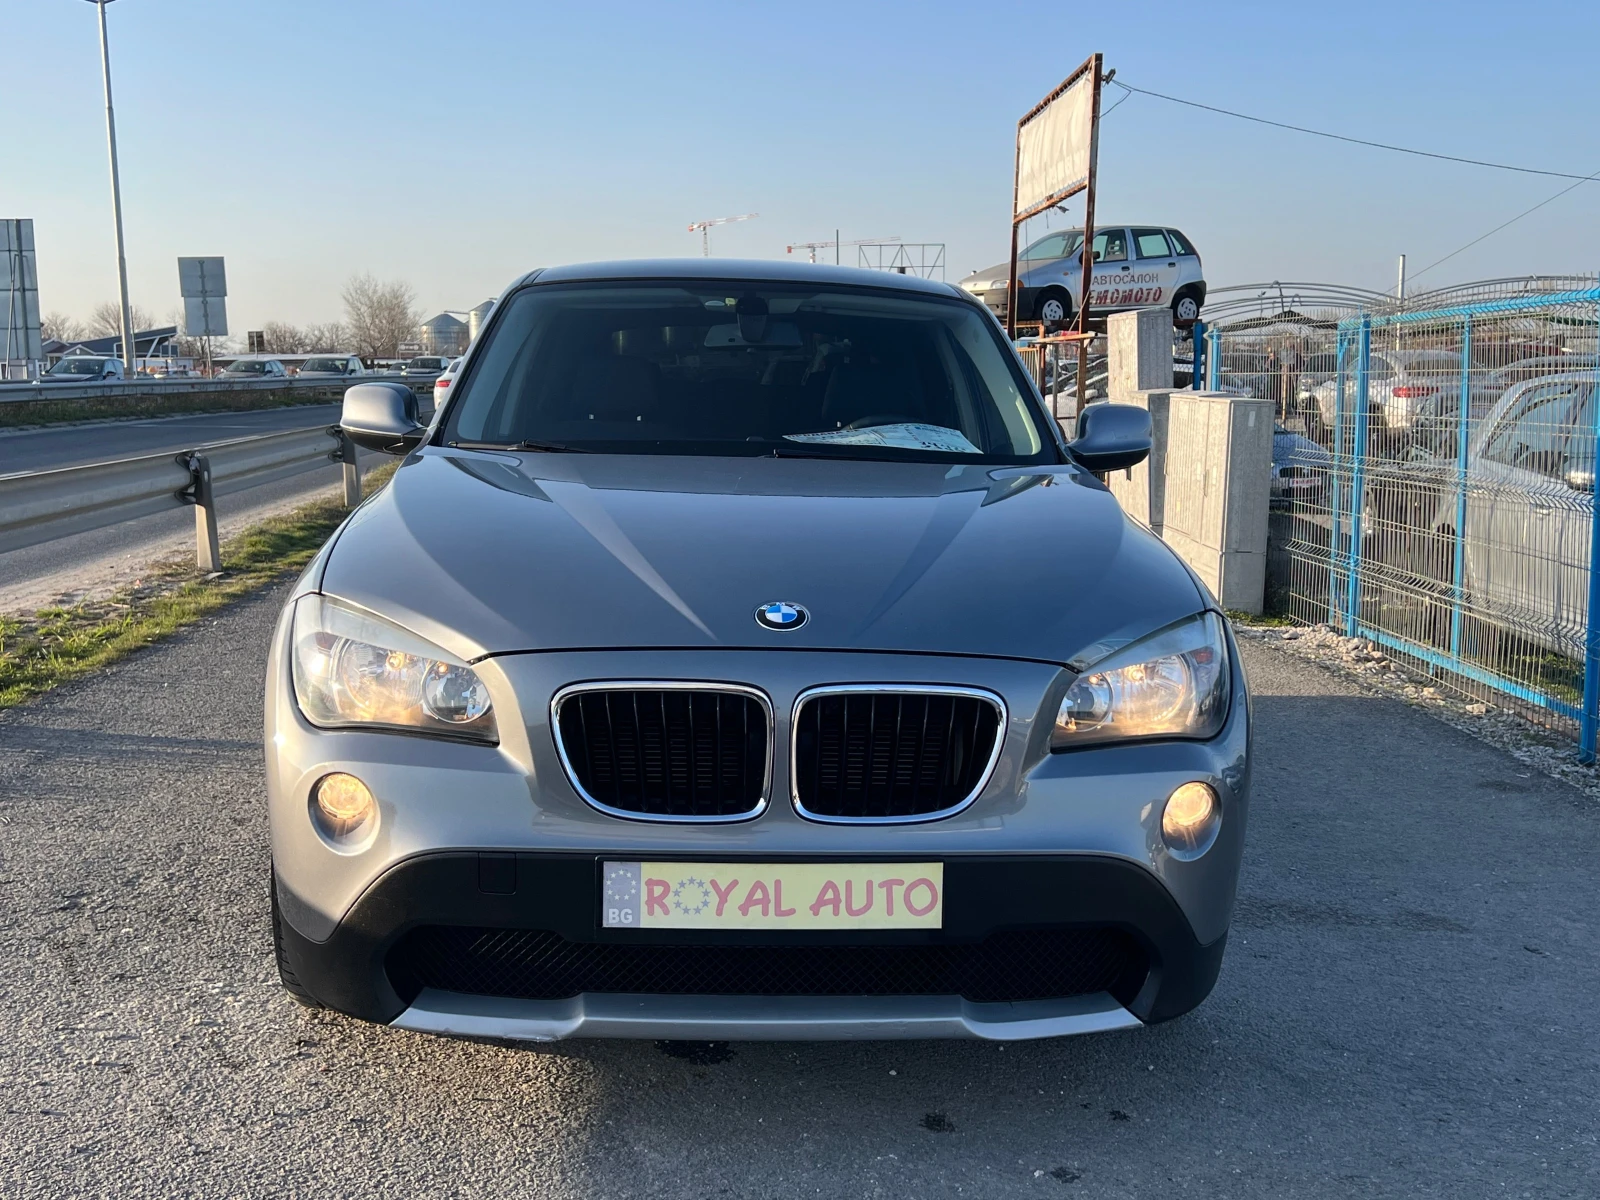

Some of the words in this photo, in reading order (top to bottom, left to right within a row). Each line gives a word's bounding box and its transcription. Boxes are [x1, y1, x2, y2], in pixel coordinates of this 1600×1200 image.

[1092, 273, 1159, 286] АВТОСАЛОН
[809, 877, 939, 917] AUTO
[608, 908, 633, 924] BG
